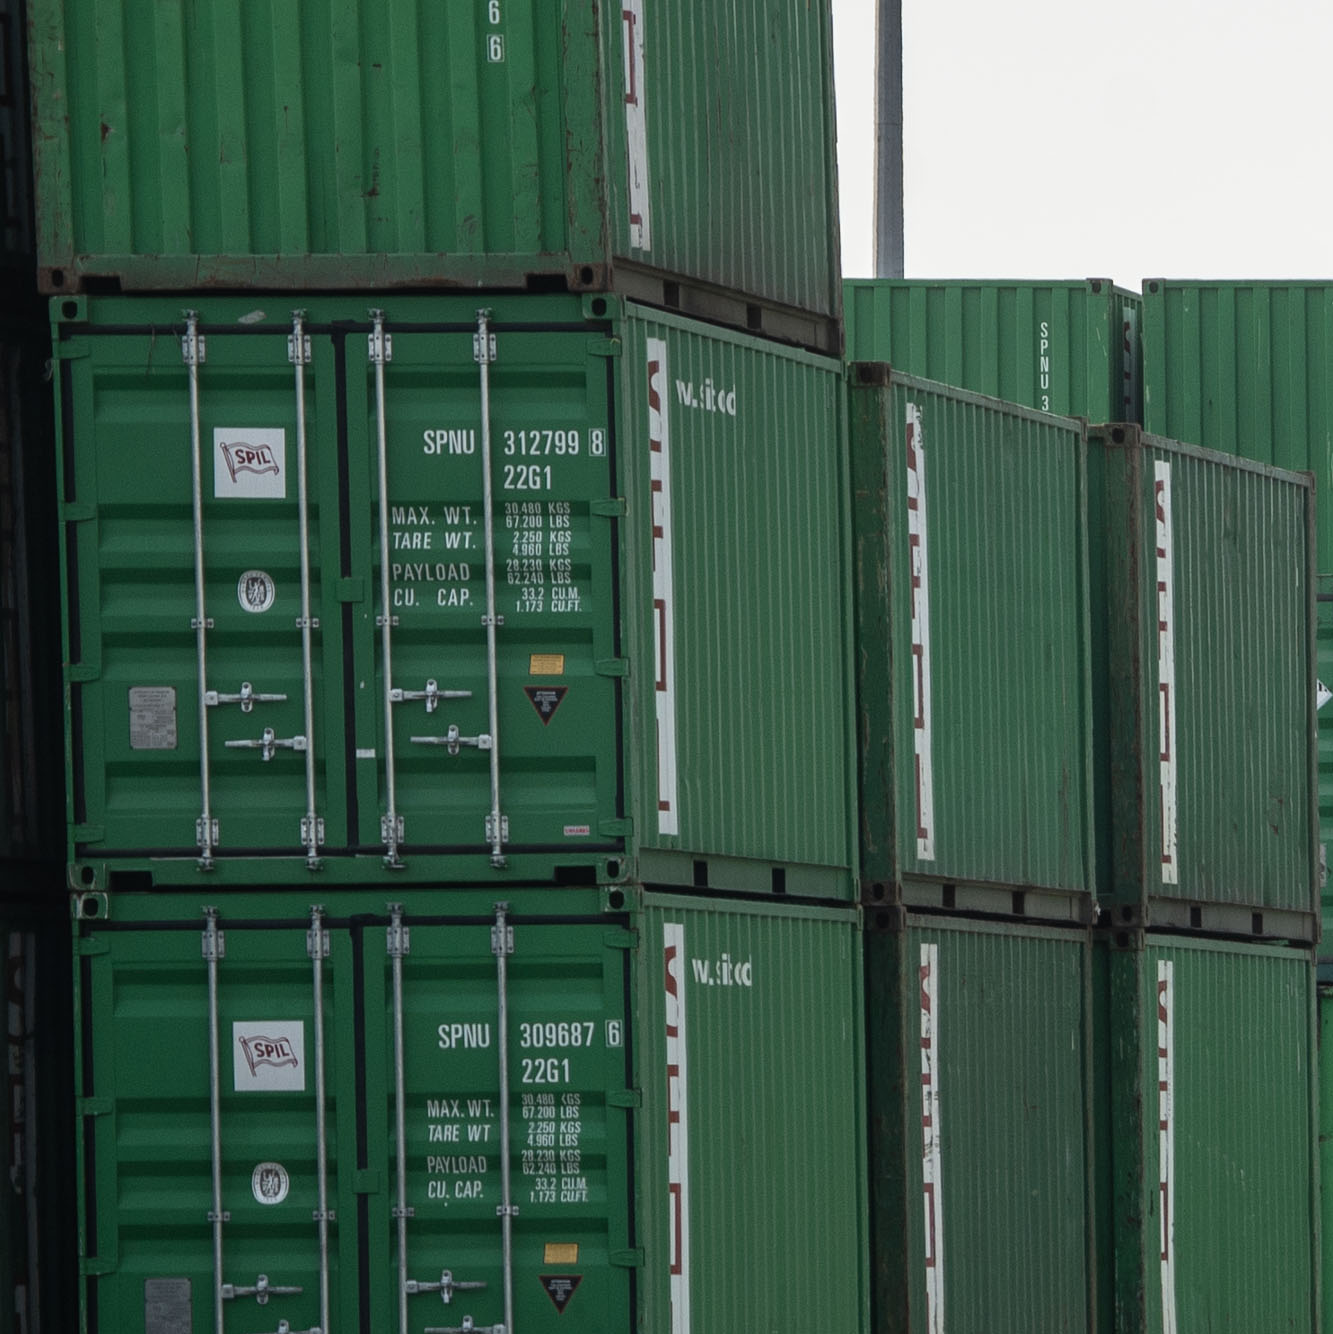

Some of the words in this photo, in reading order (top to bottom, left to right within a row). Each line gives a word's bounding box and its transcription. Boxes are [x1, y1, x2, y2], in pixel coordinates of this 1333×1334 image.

[490, 37, 501, 61] 6
[1040, 322, 1049, 390] SPNU
[423, 430, 475, 455] SPNU
[504, 430, 579, 455] 312799
[590, 430, 605, 455] 8
[235, 449, 271, 465] SPIL
[504, 465, 551, 489] 22G1
[391, 506, 436, 525] MAX.
[444, 506, 478, 525] WT.
[505, 502, 542, 514] 30.480
[548, 502, 571, 514] KGS
[506, 515, 542, 528] 67.200
[549, 515, 570, 528] LBS
[393, 532, 433, 549] TARE
[445, 532, 477, 549] WT.
[549, 530, 572, 542] KGS
[549, 544, 569, 556] LBS
[392, 563, 471, 580] PAYLOAD
[549, 559, 572, 572] KGS
[550, 572, 571, 584] LBS
[394, 588, 420, 606] CU.
[437, 588, 473, 606] CAP.
[522, 588, 544, 600] 33.2
[516, 600, 543, 612] 1.173
[439, 1024, 490, 1048] SPNU
[520, 1022, 594, 1048] 309687
[607, 1021, 621, 1047] 6
[254, 1041, 290, 1060] SPIL
[522, 1058, 570, 1083] 22G1
[427, 1099, 465, 1118] MAX.
[467, 1099, 494, 1118] WT.
[560, 1106, 579, 1119] LBS
[428, 1125, 460, 1142] TARE
[560, 1122, 581, 1133] KGS
[560, 1135, 578, 1146] LBS
[560, 1150, 581, 1162] KGS
[427, 1156, 487, 1173] PAYLOAD
[561, 1163, 580, 1175] LBS
[428, 1180, 450, 1199] CU.
[455, 1180, 484, 1198] CAP.
[535, 1178, 557, 1190] 33.2
